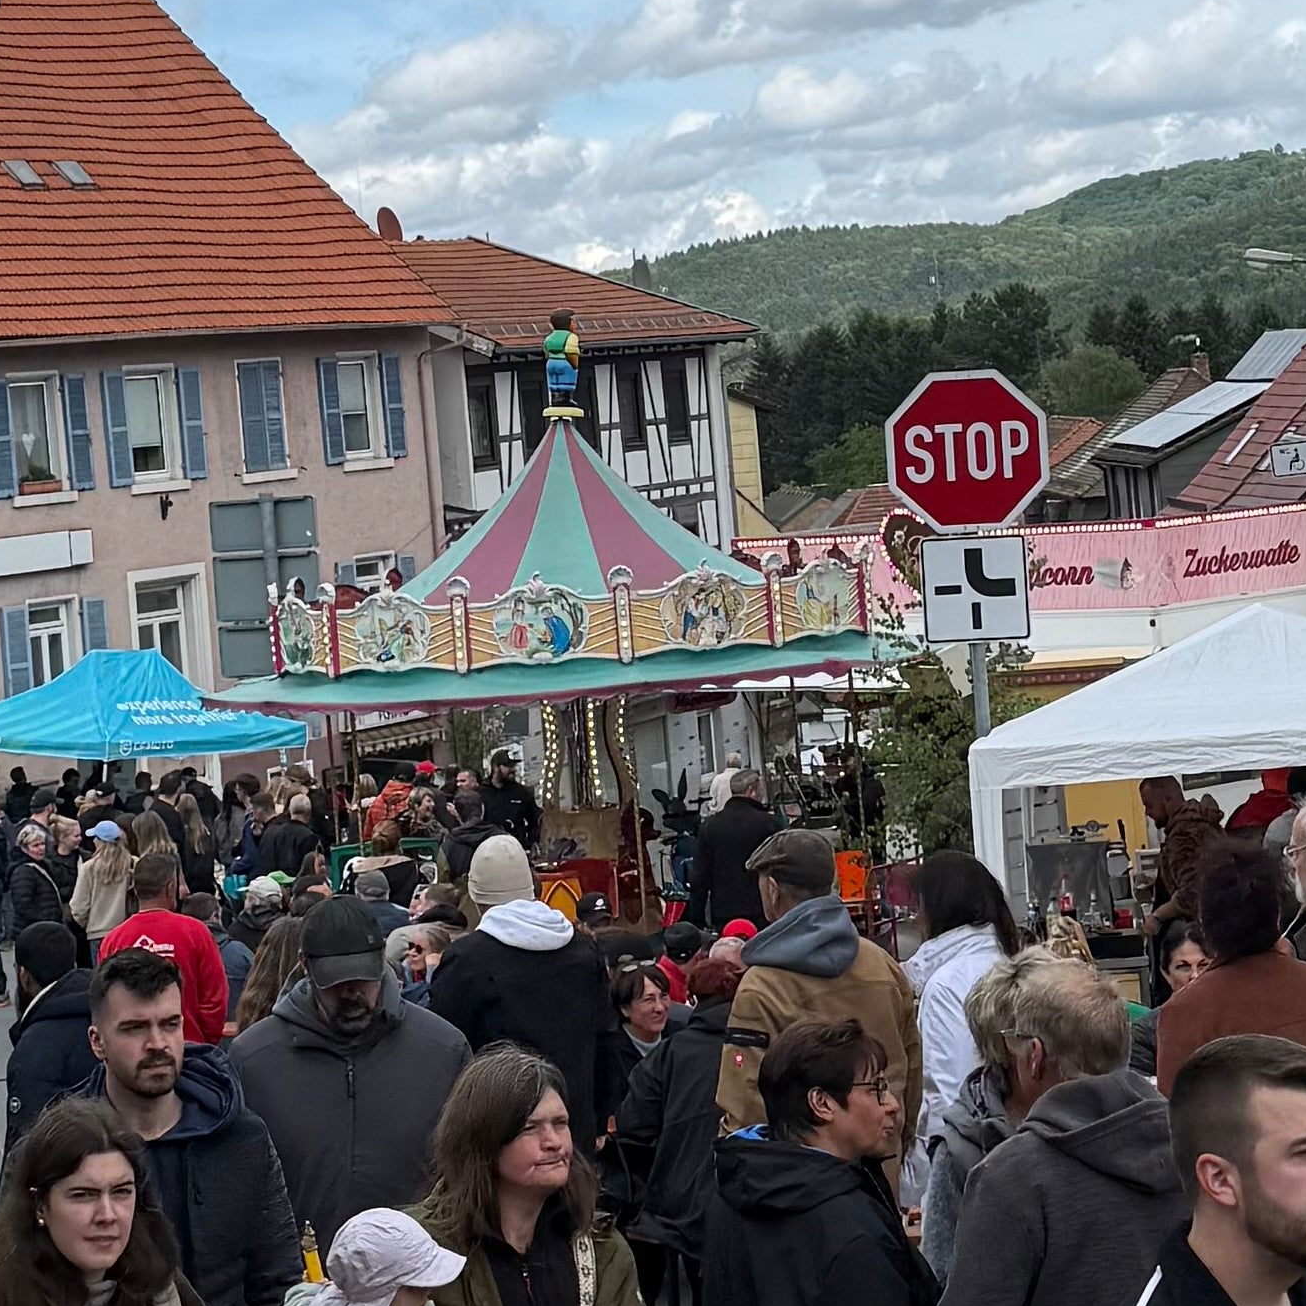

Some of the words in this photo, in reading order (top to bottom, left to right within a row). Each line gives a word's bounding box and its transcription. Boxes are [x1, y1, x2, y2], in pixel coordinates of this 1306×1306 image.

[904, 420, 1029, 484] STOP
[1183, 539, 1301, 578] Zuckerwatte
[1028, 566, 1095, 591] pcorn
[131, 714, 175, 726] more
